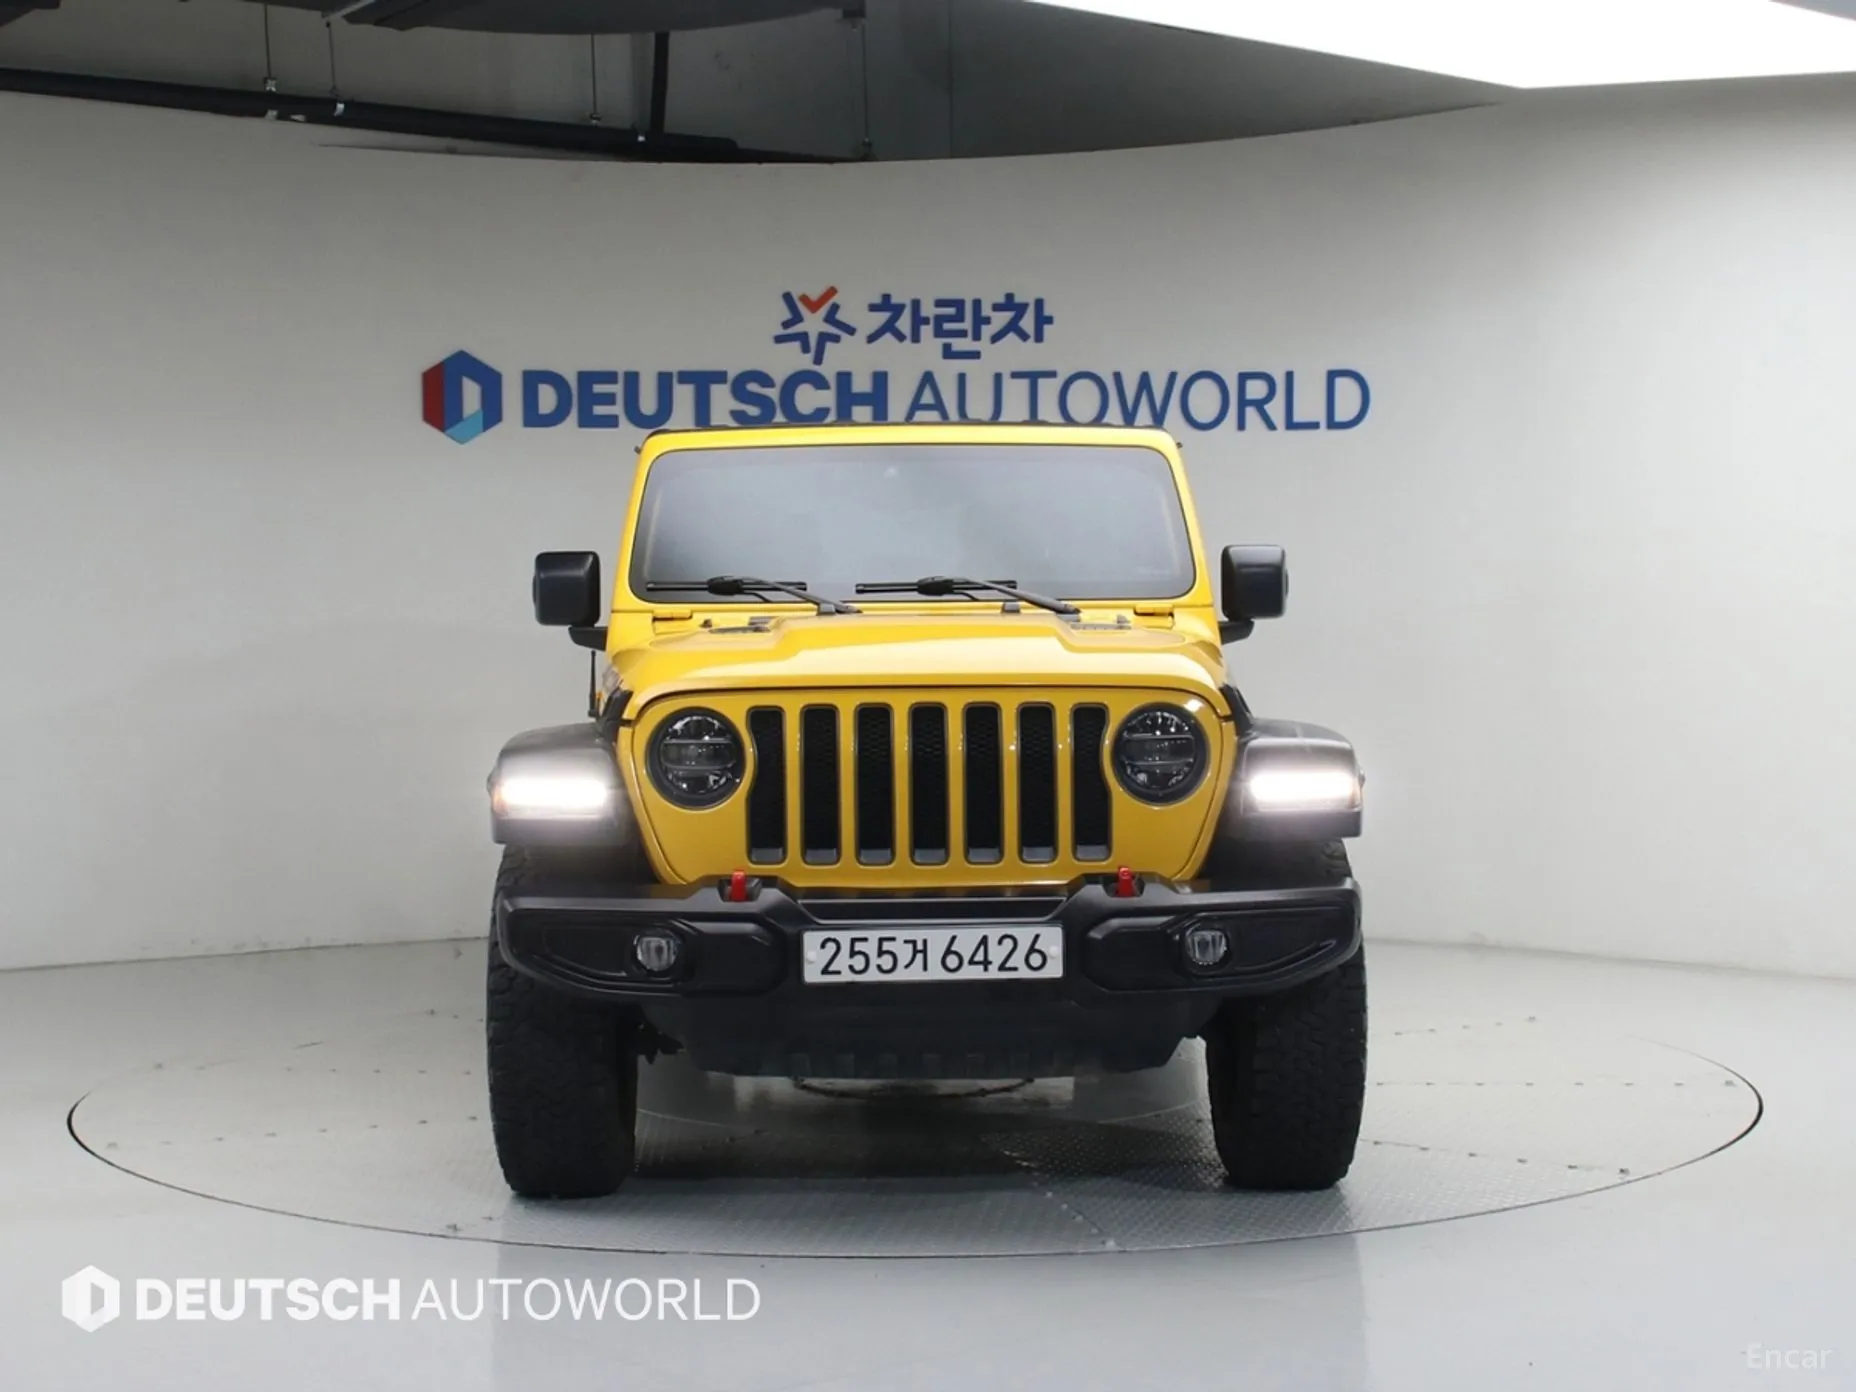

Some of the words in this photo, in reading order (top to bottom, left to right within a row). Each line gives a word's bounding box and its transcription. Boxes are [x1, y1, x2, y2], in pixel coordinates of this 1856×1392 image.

[866, 293, 1054, 358] 차란차
[522, 369, 887, 429] DEUTSCH
[904, 369, 1371, 431] AUTOWORLD
[940, 933, 1048, 974] 6426
